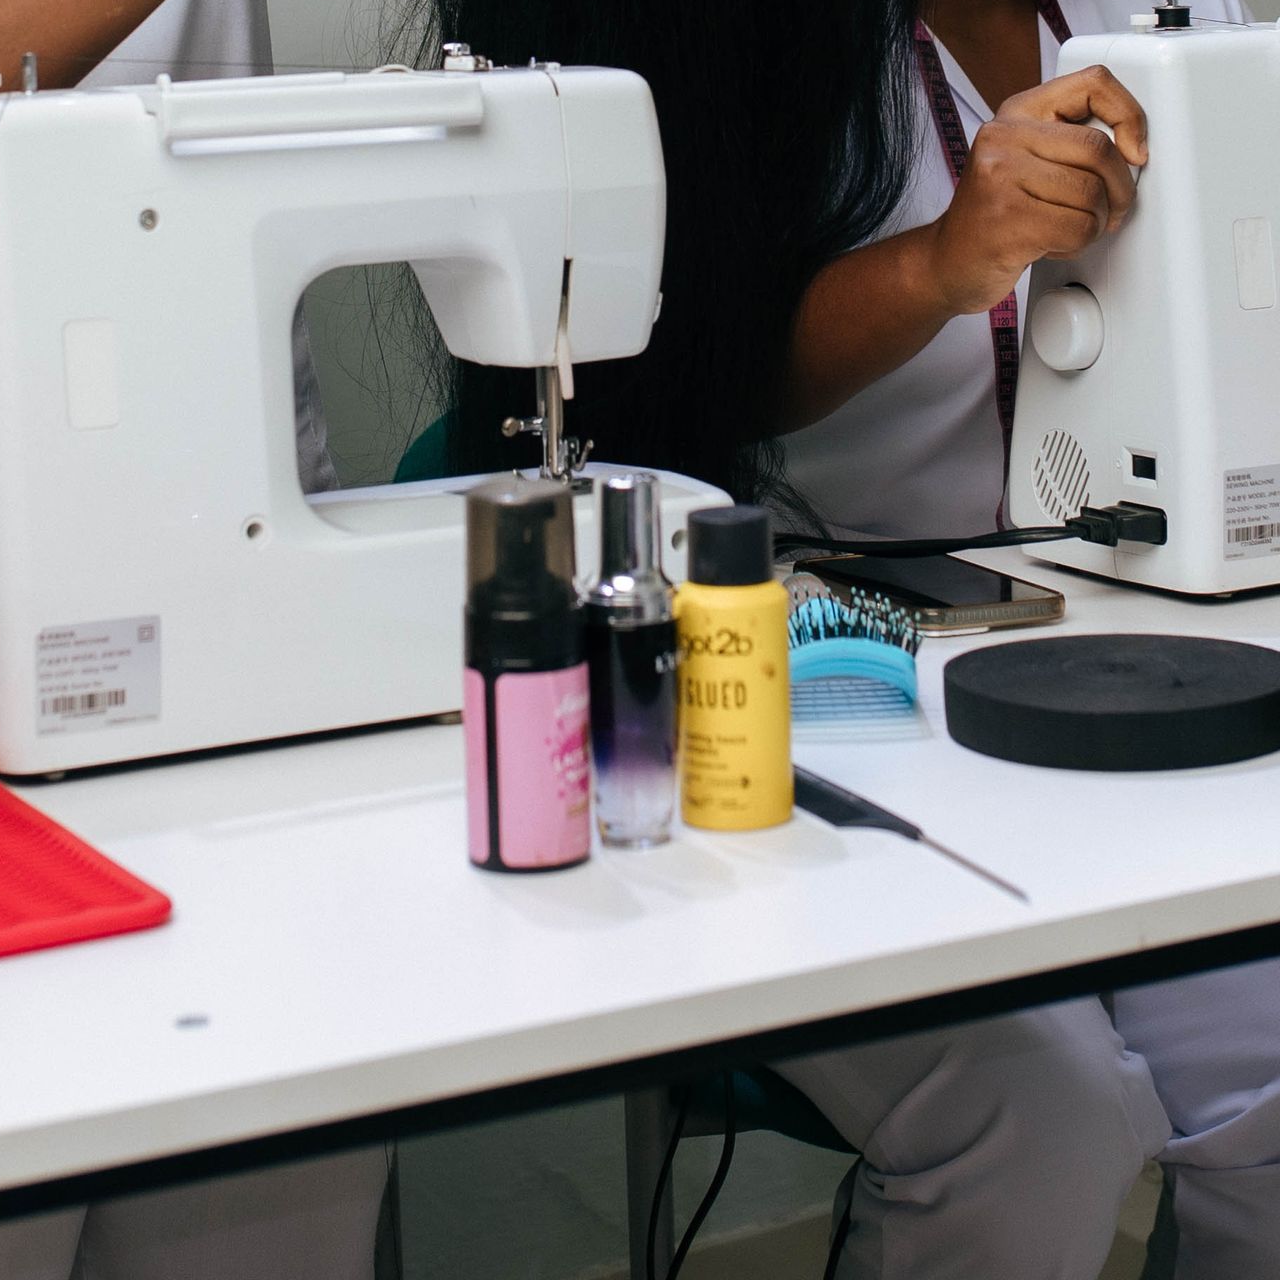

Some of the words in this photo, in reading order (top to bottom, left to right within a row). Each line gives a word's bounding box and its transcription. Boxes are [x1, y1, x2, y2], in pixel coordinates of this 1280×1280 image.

[998, 317, 1010, 326] 120
[679, 628, 754, 661] got2b
[686, 678, 747, 710] GLUED
